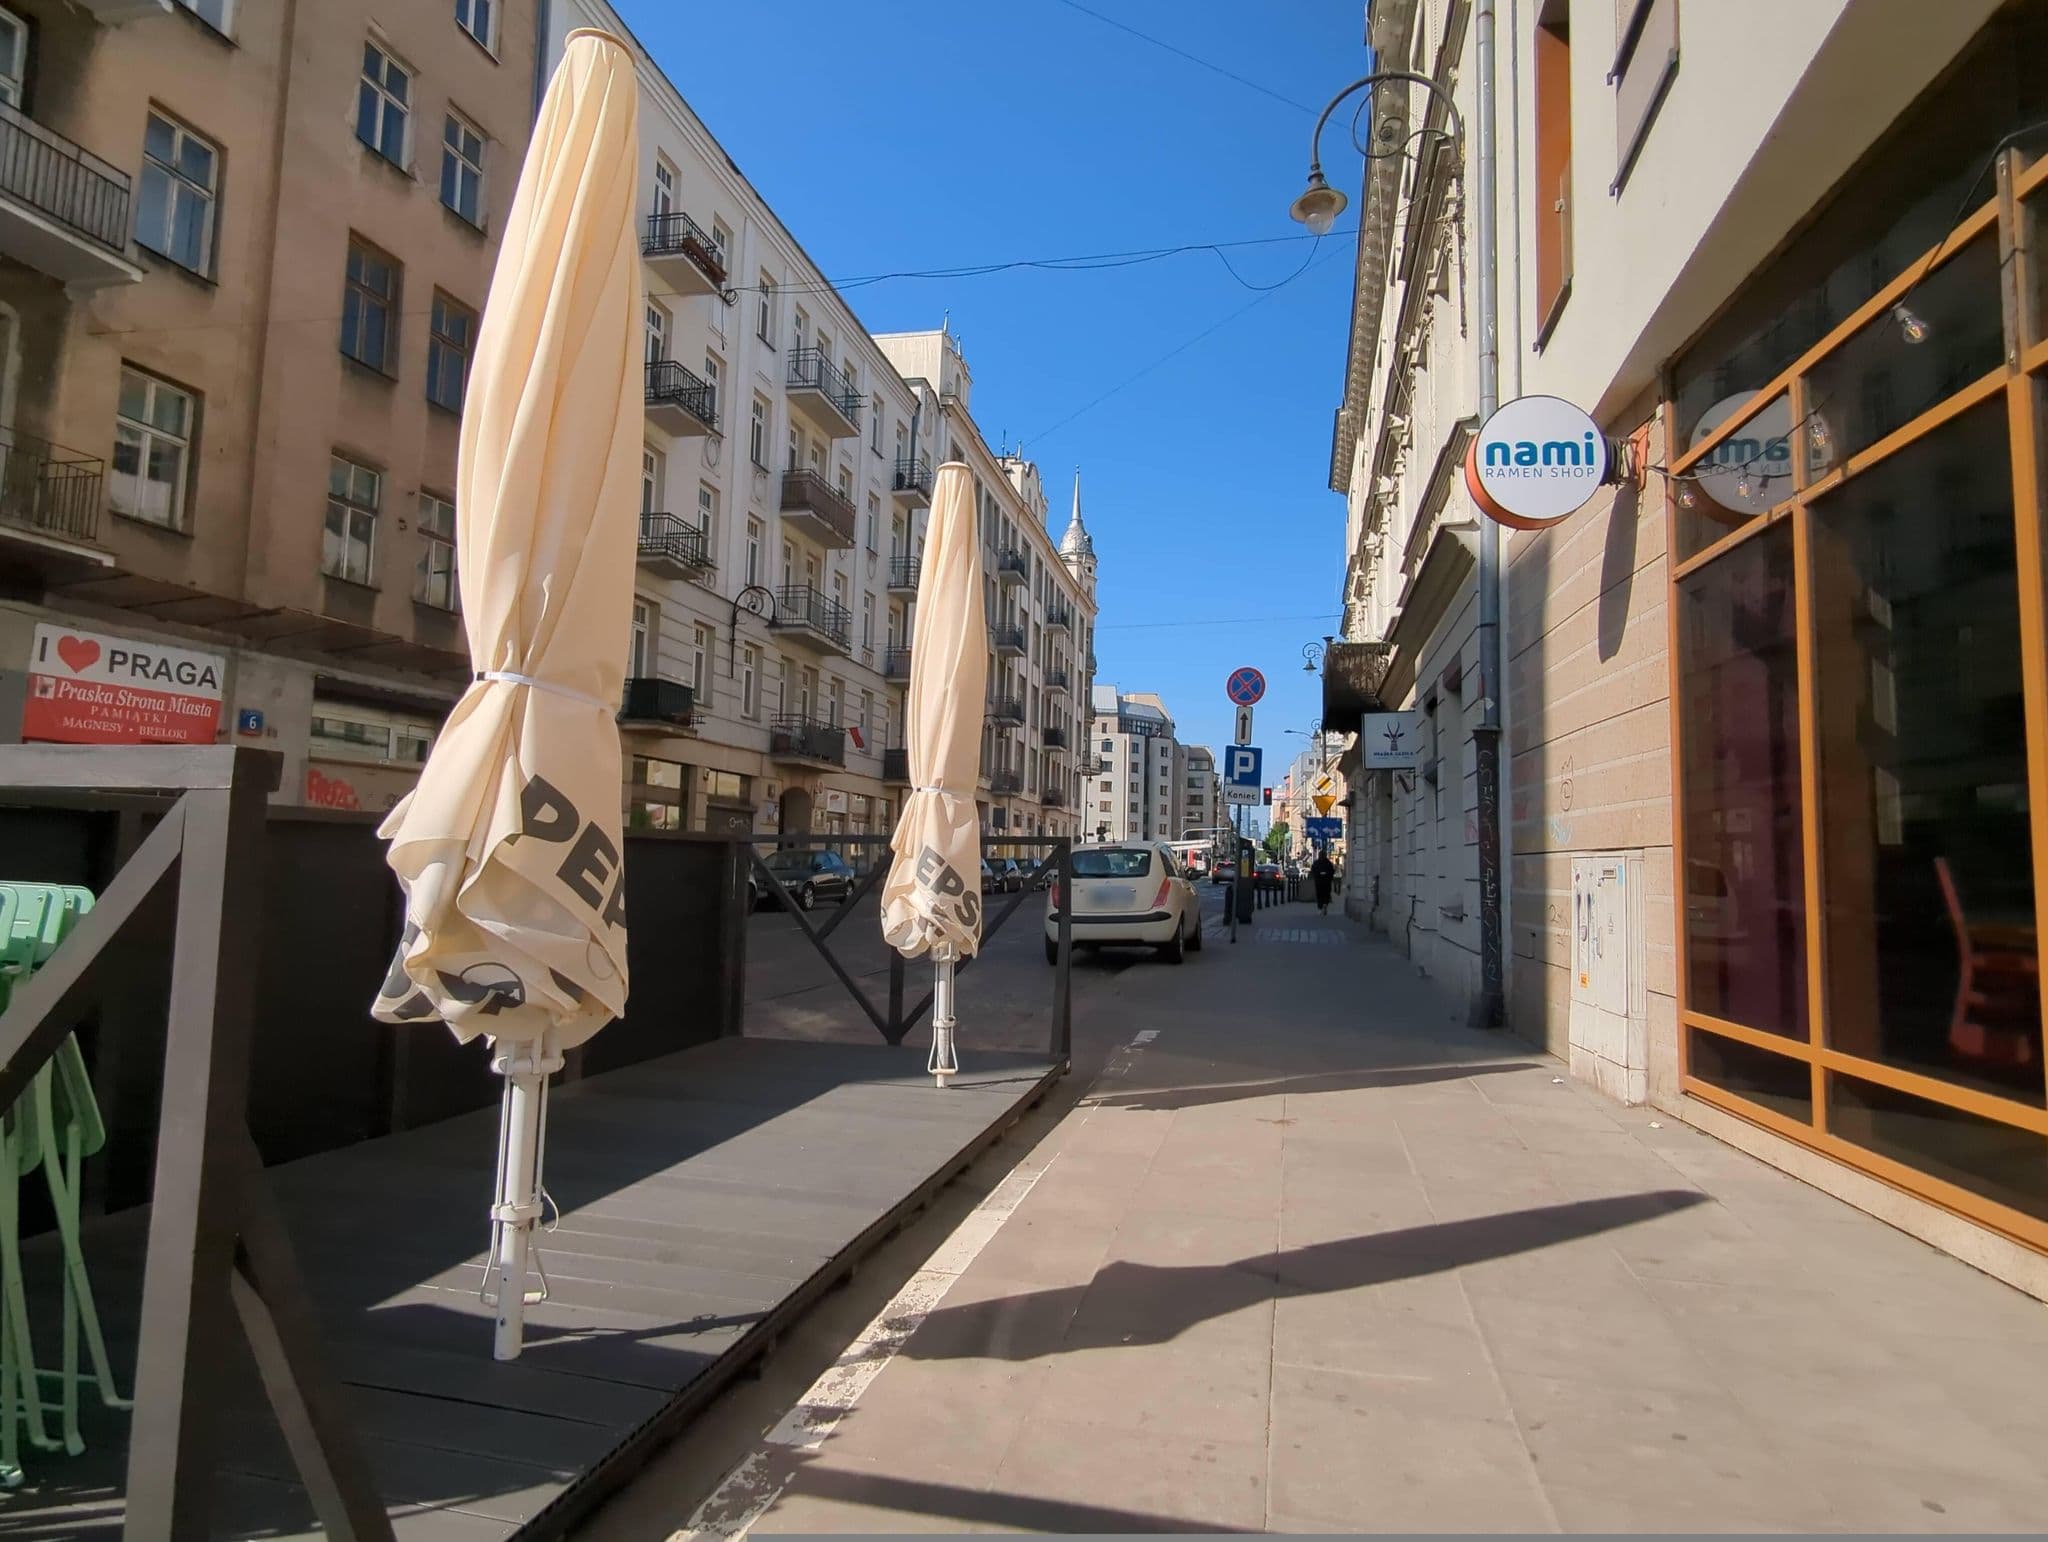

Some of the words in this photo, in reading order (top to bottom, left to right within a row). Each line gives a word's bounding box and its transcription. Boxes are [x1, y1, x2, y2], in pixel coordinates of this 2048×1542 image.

[1486, 431, 1594, 466] nami
[1485, 467, 1543, 478] RAMEN
[1550, 467, 1595, 478] SHOP
[39, 636, 48, 662] I
[108, 649, 217, 690] PRAGA
[57, 681, 113, 705] Praska
[116, 689, 165, 712] Strona
[168, 697, 212, 718] Miasta
[91, 706, 168, 724] PAMIĄTKI
[249, 716, 257, 730] 6
[62, 716, 124, 733] MAGNESY
[139, 725, 187, 740] BRELOKI
[1233, 750, 1255, 781] P
[1227, 789, 1257, 801] Koniec
